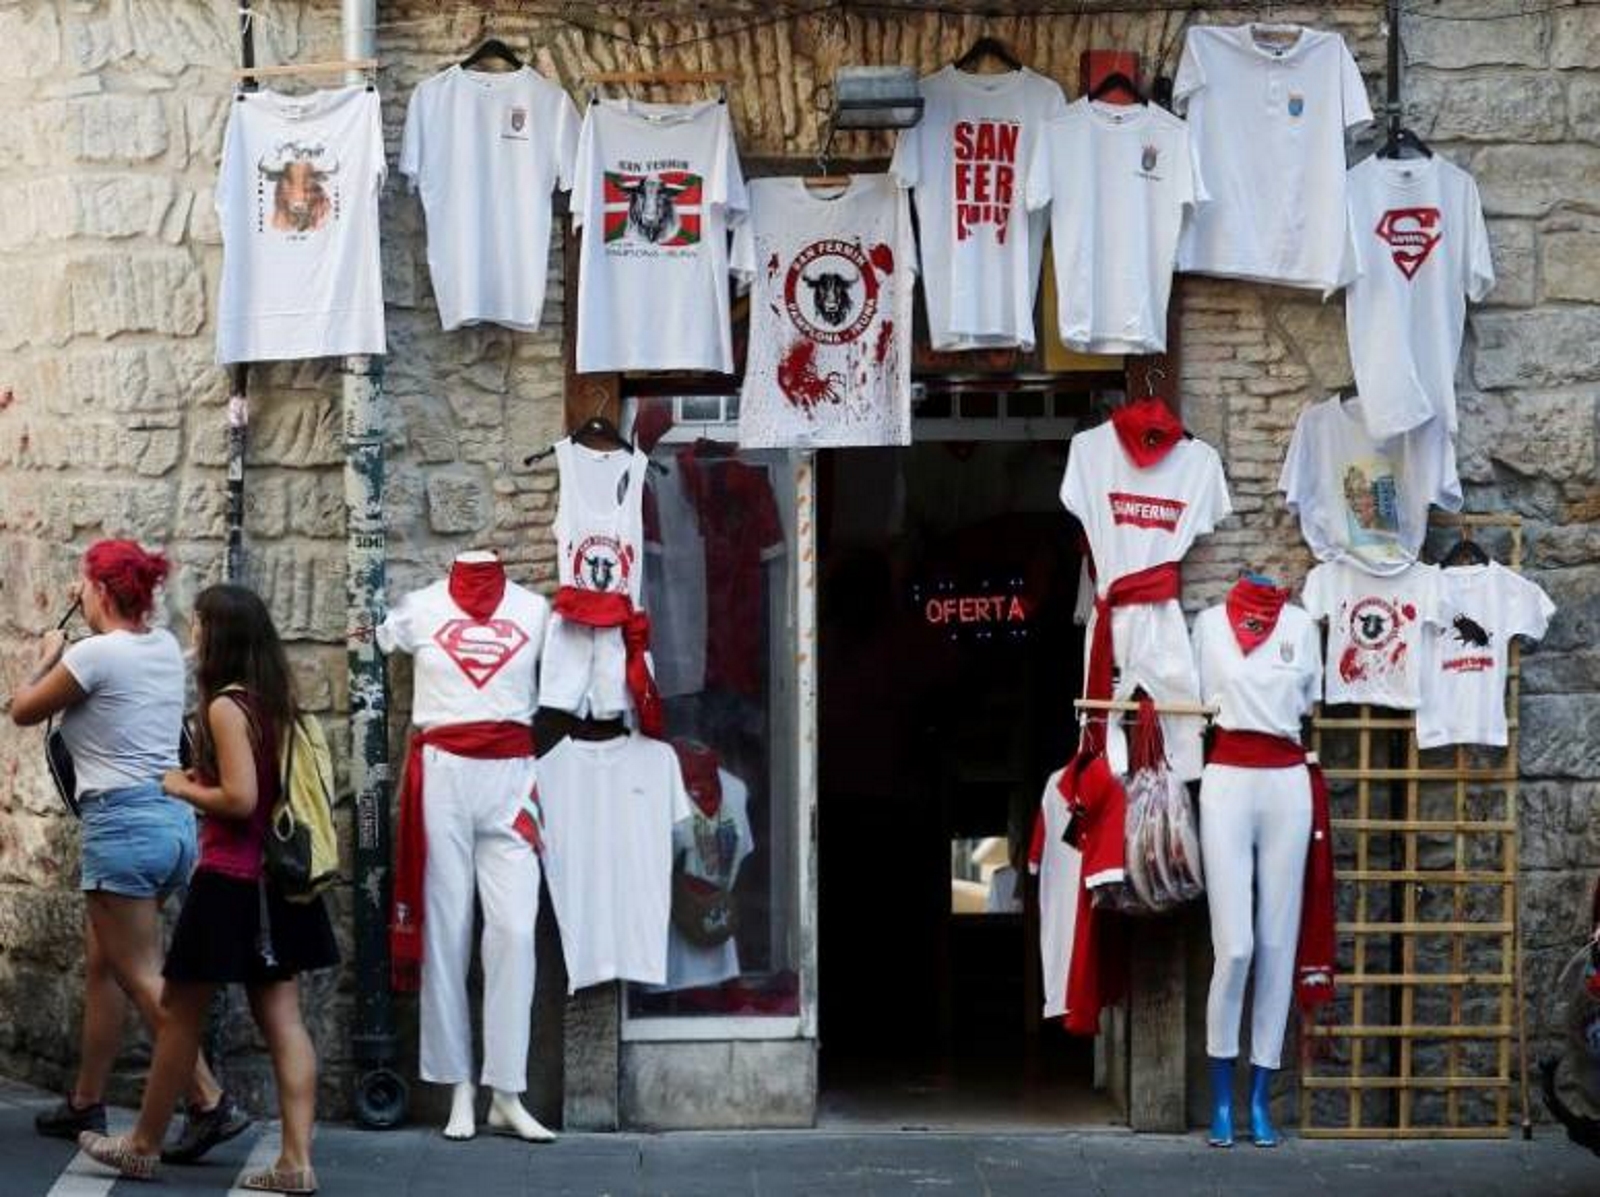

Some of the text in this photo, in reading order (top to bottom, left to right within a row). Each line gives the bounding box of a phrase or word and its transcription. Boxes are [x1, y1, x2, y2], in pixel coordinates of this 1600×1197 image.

[955, 121, 1019, 163] SAN
[955, 163, 1014, 204] FER
[792, 242, 866, 271] SAN FERMIN
[926, 595, 1025, 623] OFERTA
